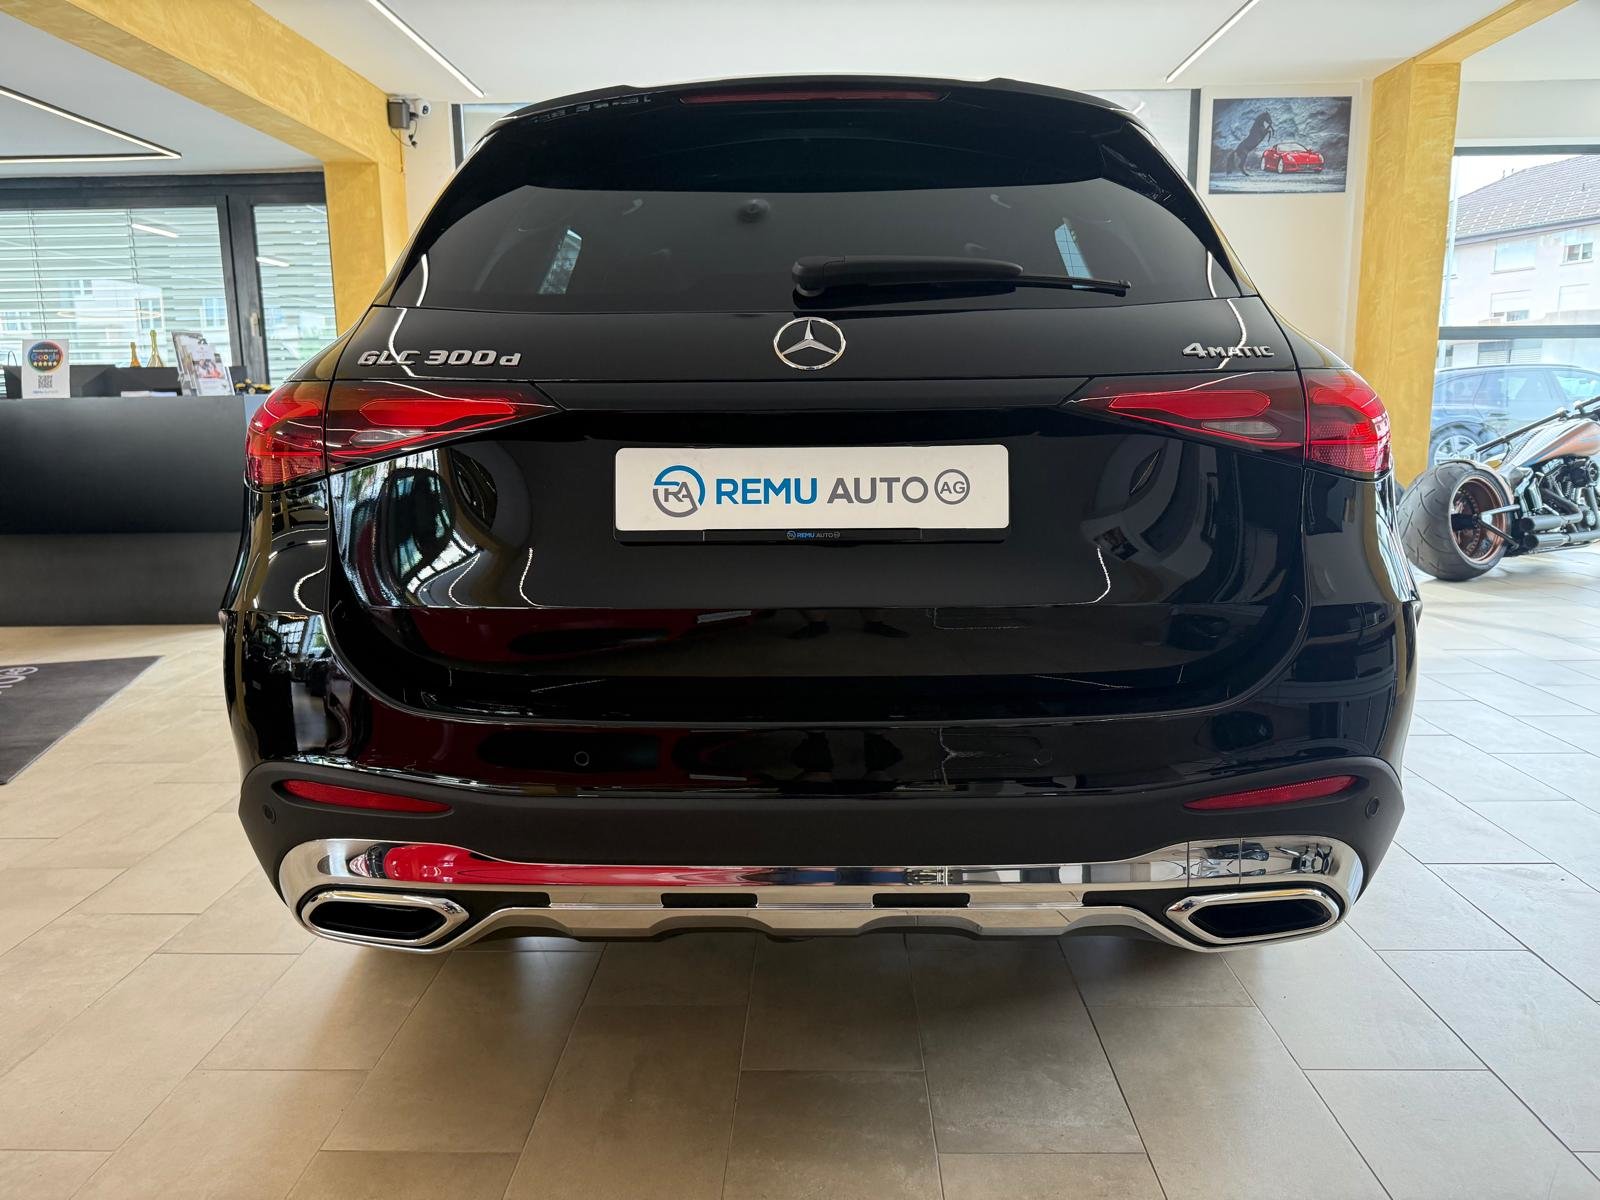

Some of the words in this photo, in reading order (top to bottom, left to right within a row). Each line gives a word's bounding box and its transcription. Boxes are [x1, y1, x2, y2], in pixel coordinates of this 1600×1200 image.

[357, 350, 421, 366] GLC
[1182, 342, 1275, 359] 4MATIC
[715, 477, 818, 505] REMU
[826, 476, 929, 504] AUTO
